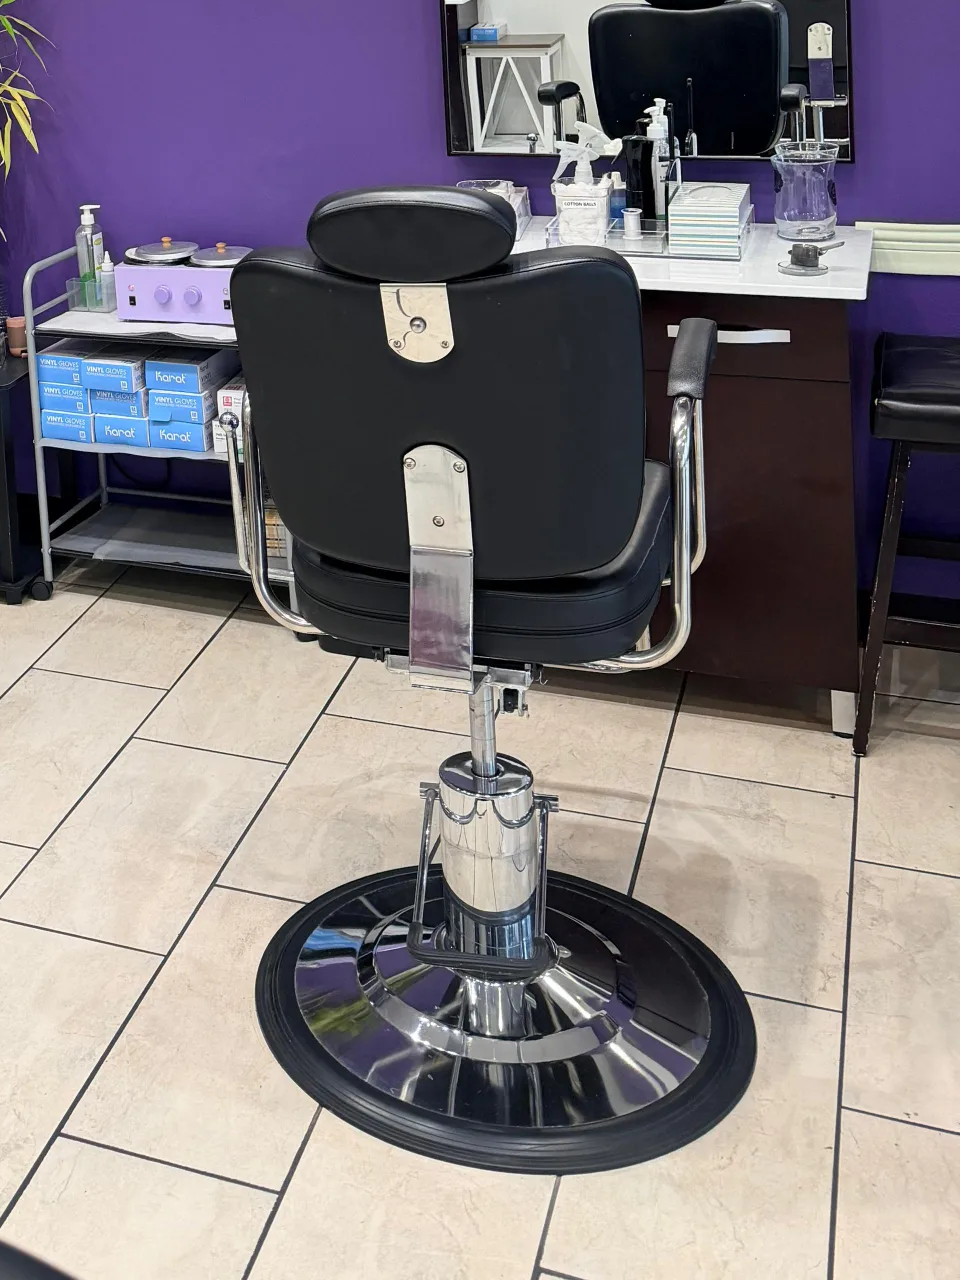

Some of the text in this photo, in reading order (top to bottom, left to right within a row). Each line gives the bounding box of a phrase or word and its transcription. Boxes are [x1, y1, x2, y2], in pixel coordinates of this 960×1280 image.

[155, 371, 186, 384] Karat
[155, 396, 173, 404] VINYL
[174, 398, 197, 406] GLOVES
[64, 417, 85, 425] GLOVES
[105, 425, 135, 438] Karat
[159, 429, 191, 442] Karat
